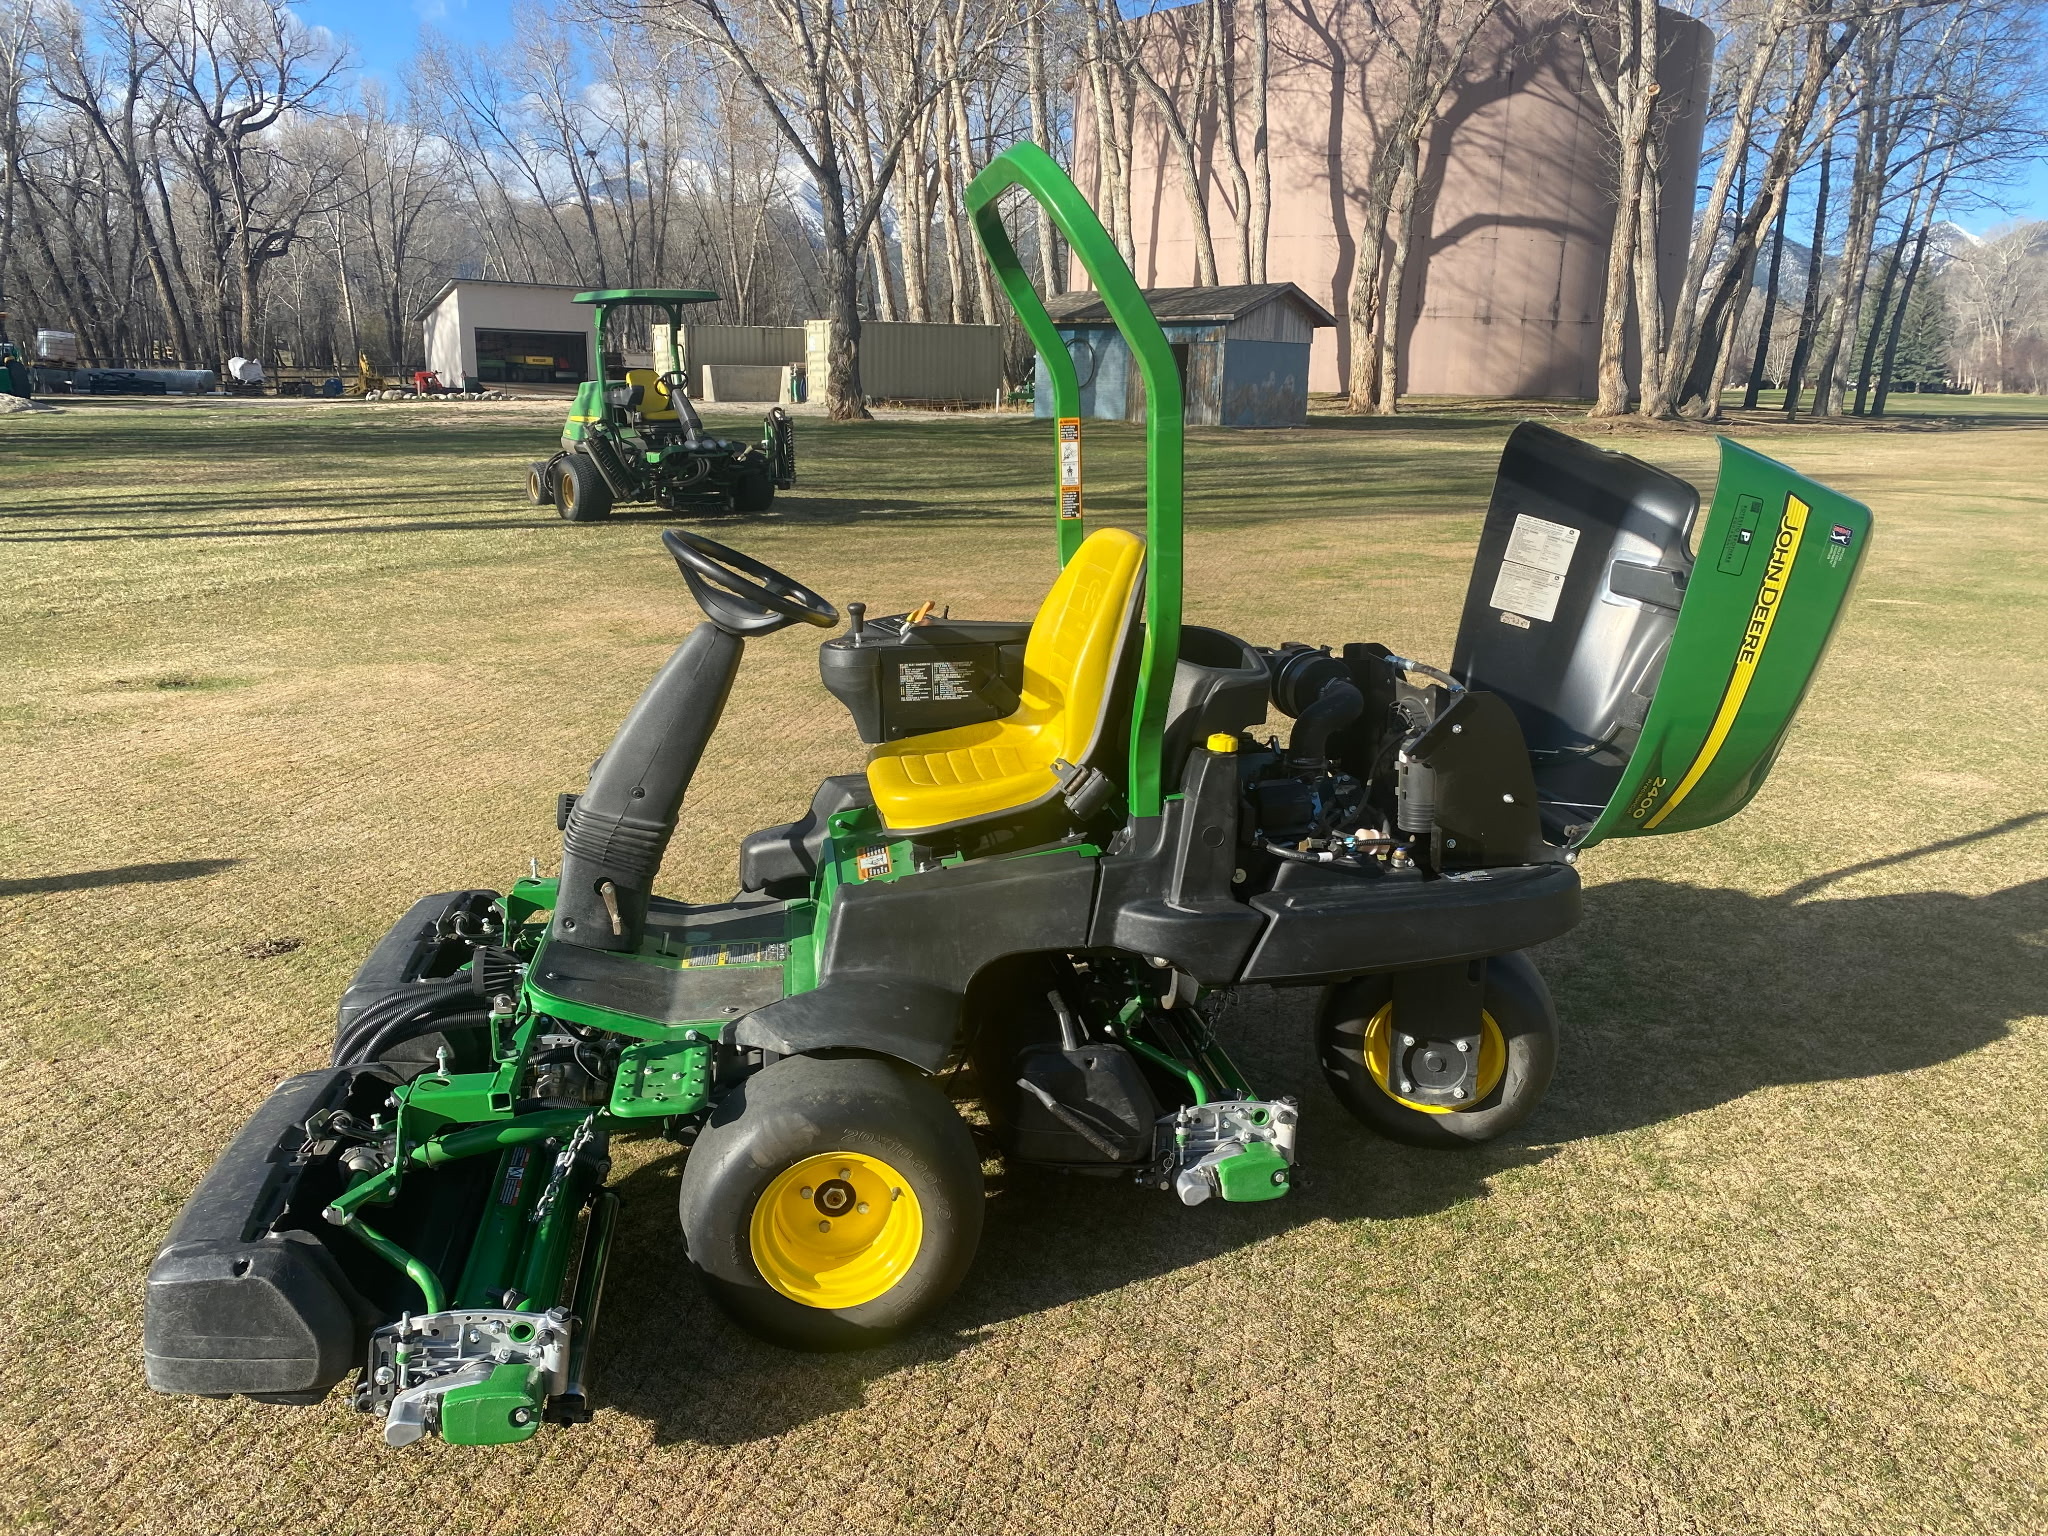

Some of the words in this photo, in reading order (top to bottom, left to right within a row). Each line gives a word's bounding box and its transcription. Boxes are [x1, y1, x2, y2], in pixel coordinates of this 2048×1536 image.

[1766, 516, 1798, 582] JOHN
[1739, 587, 1779, 664] DEERE
[1633, 777, 1667, 818] 2400
